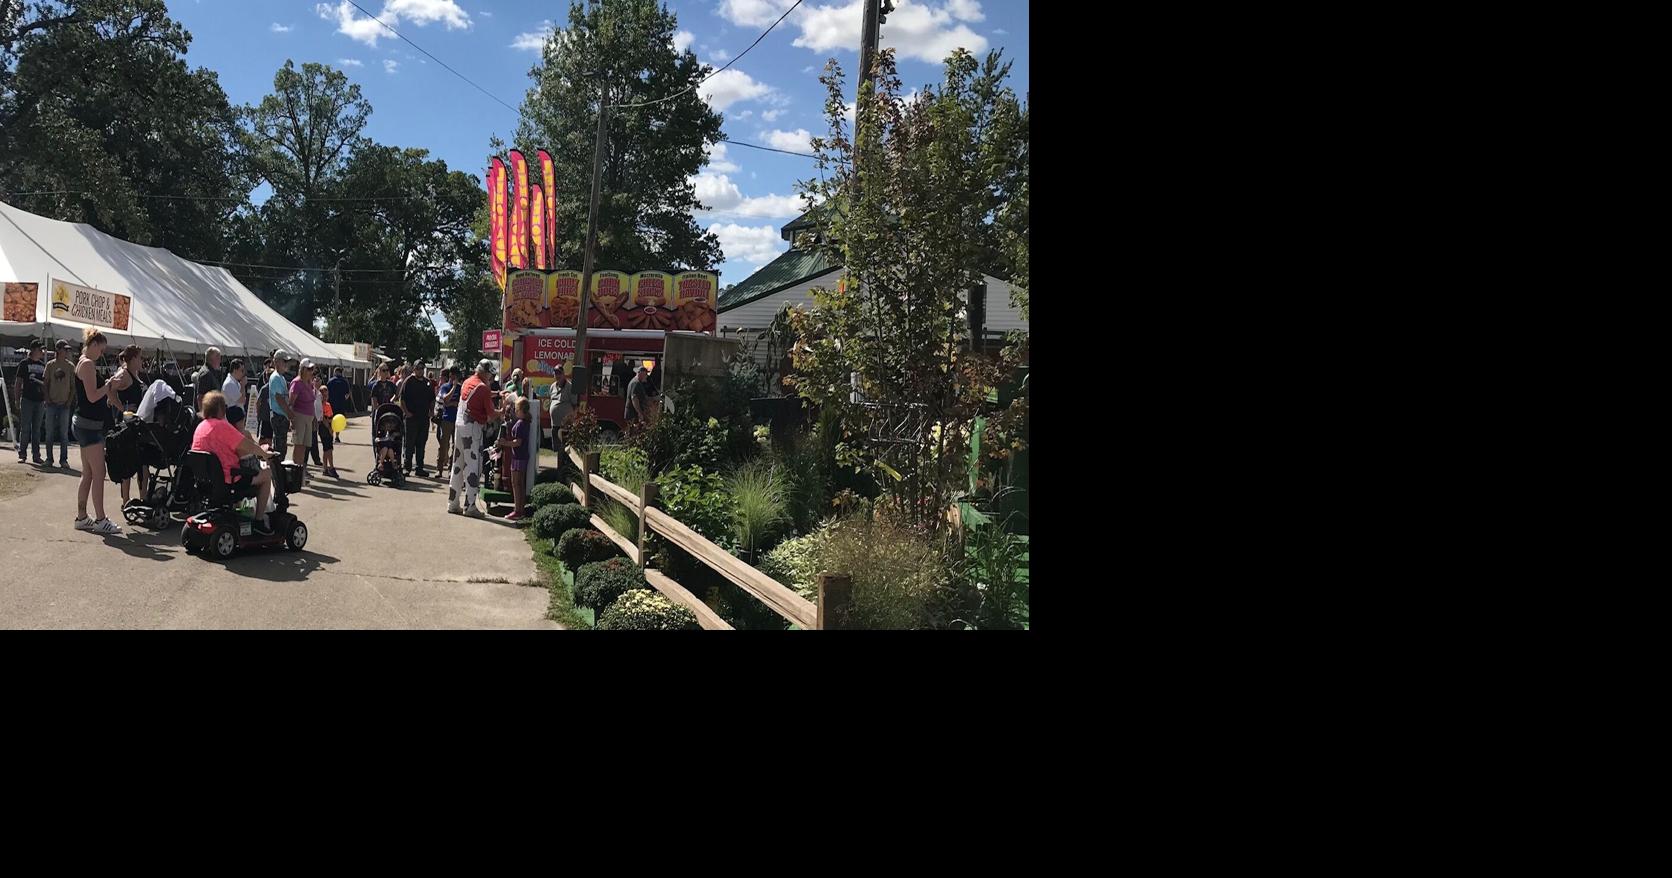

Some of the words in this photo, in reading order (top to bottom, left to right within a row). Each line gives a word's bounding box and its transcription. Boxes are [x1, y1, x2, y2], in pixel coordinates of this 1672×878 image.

[75, 290, 90, 306] PORK
[91, 294, 105, 309] CHOP
[106, 297, 110, 310] &
[71, 303, 95, 320] CHICKEN
[96, 307, 112, 324] MEALS
[538, 339, 552, 348] ICE
[554, 339, 577, 349] COLD
[534, 351, 575, 360] LEMONAD
